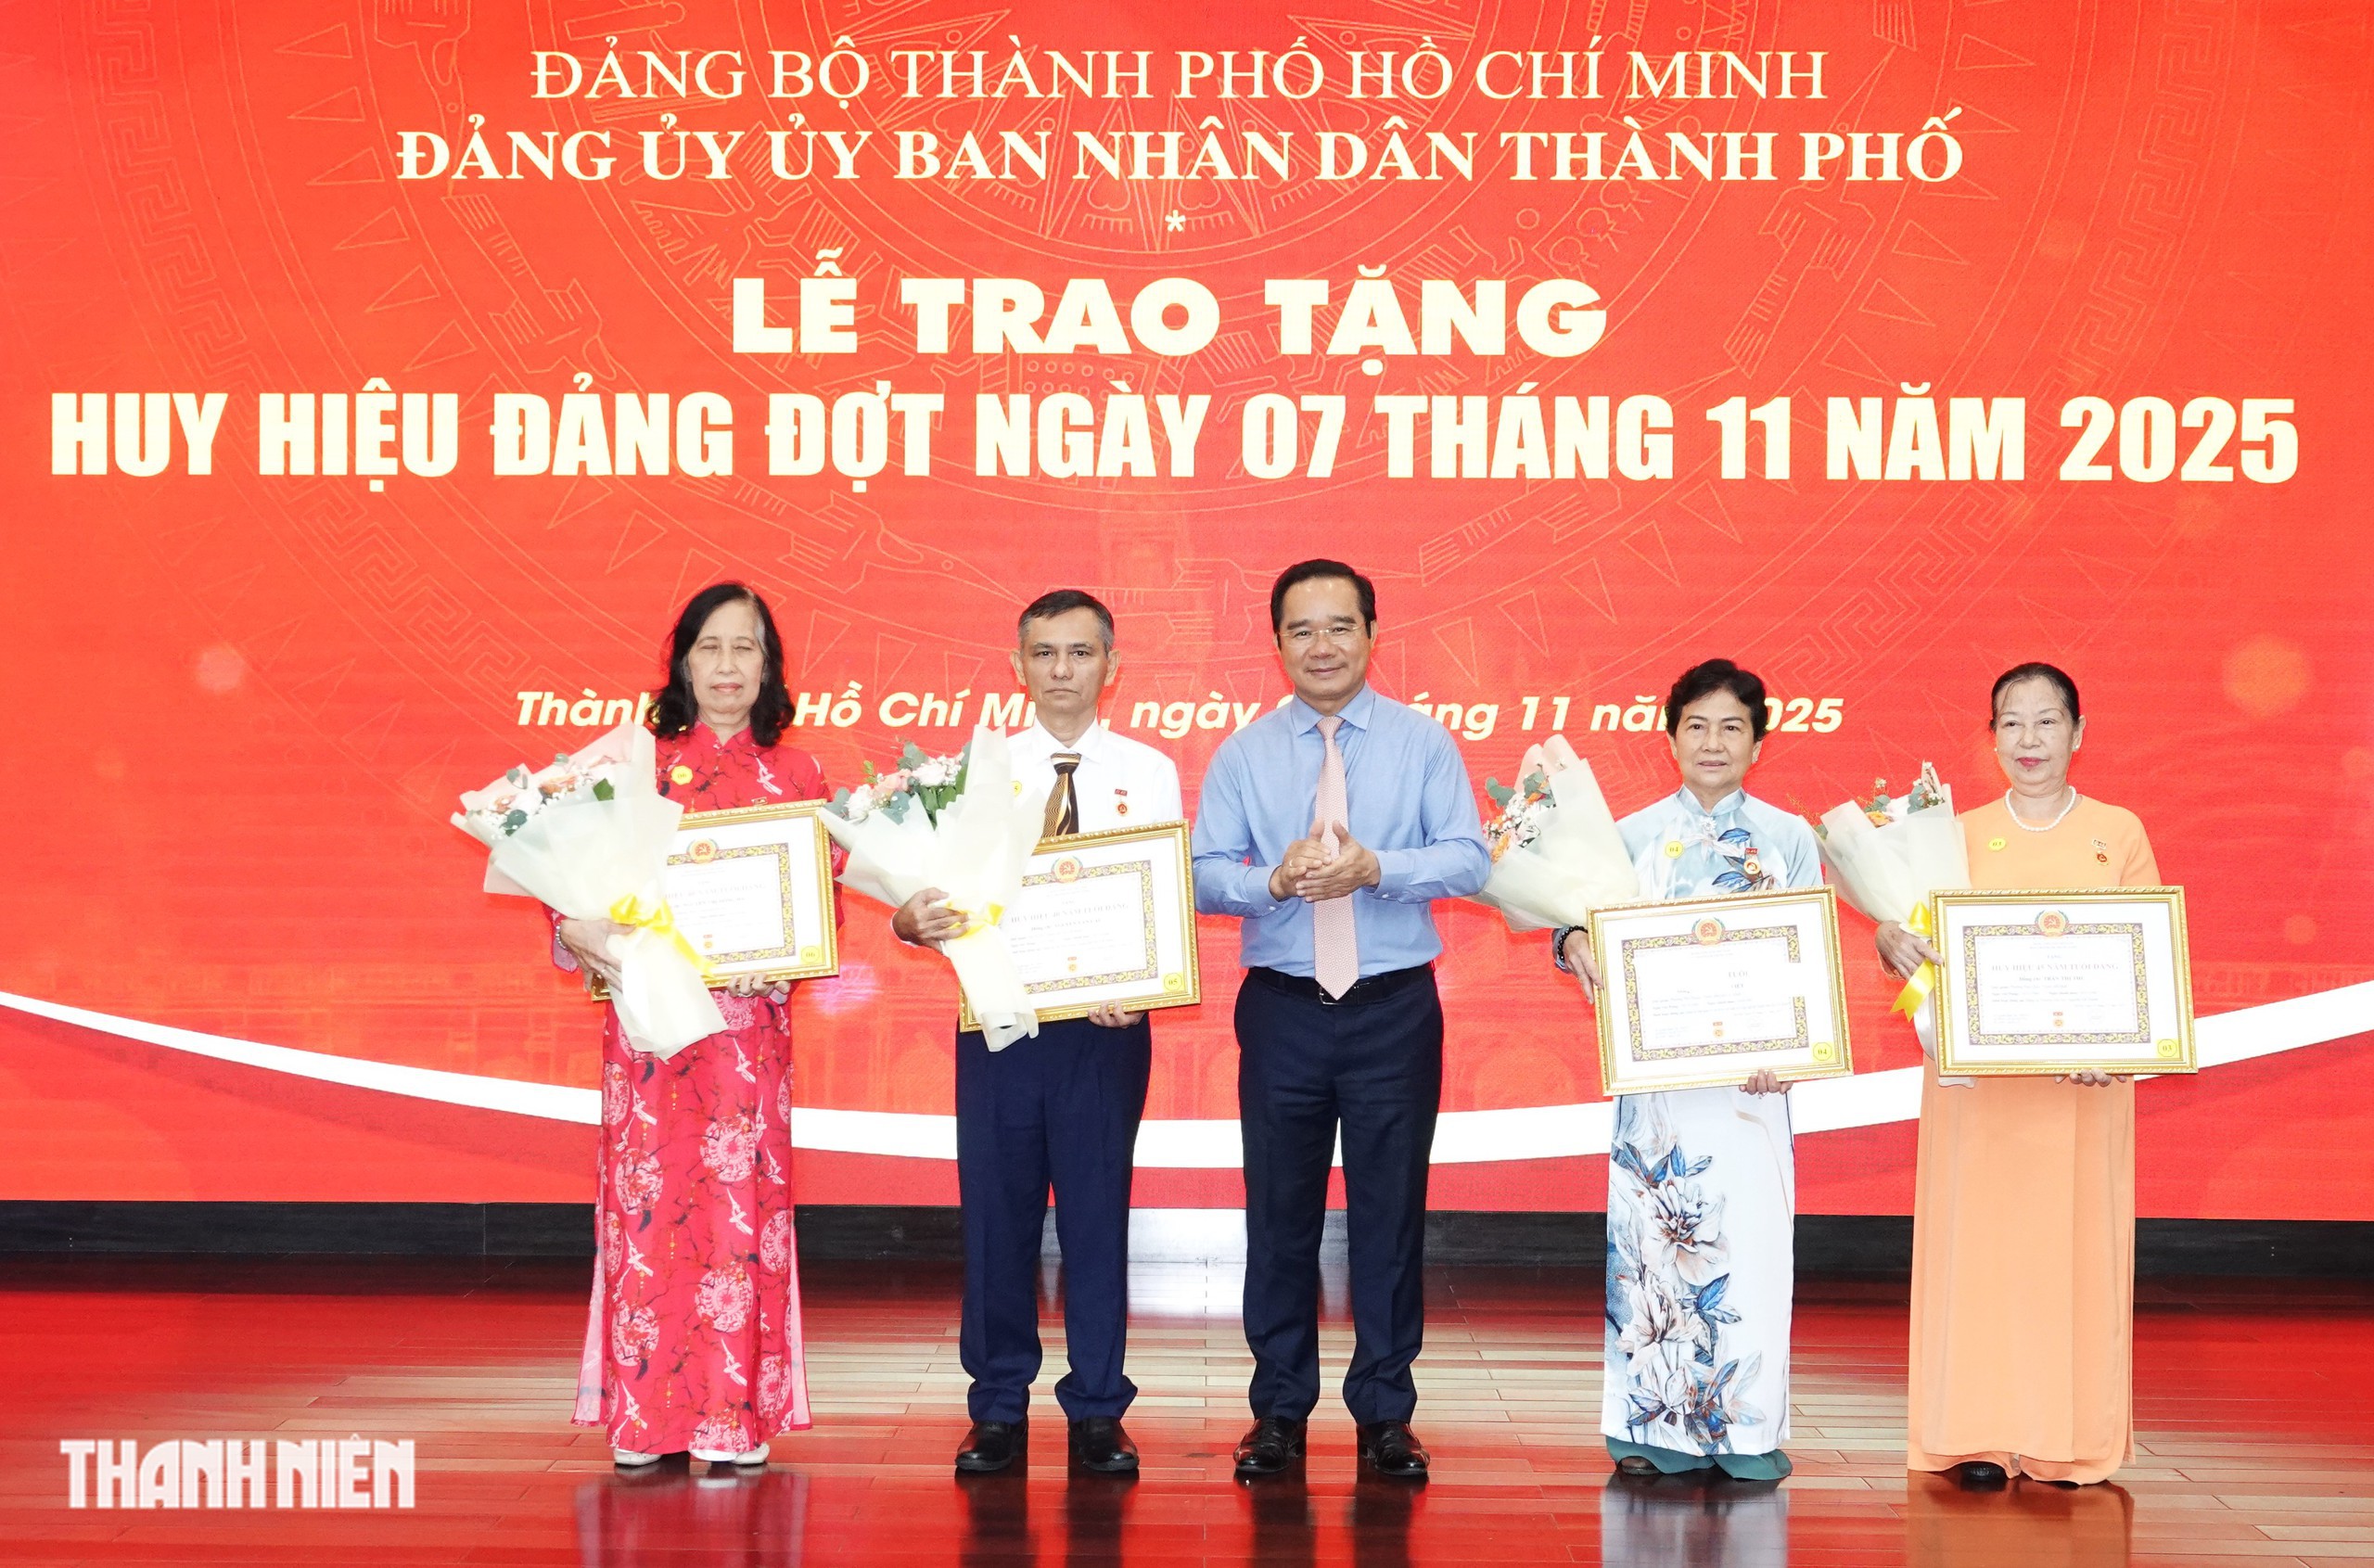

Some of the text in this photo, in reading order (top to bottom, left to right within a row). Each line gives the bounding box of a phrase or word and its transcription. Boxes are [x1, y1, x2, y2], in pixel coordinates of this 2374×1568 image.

[530, 35, 1828, 109] ĐẢNG BỘ THÀNH PHỐ HỒ CHÍ MINH
[397, 107, 1964, 184] ĐẢNG ỦY ỦY BAN NHÂN DÂN THÀNH PHỐ
[734, 248, 1608, 377] LỄ TRAO TẶNG
[52, 373, 2300, 494] HUY HIỆU ĐẢNG ĐỢT NGÀY 07 THÁNG 11 NĂM 2025
[793, 680, 863, 728] Hồ
[878, 688, 972, 727] Chí
[1130, 691, 1261, 738] ngày
[1522, 696, 1571, 732] 11
[1764, 697, 1844, 733] 025
